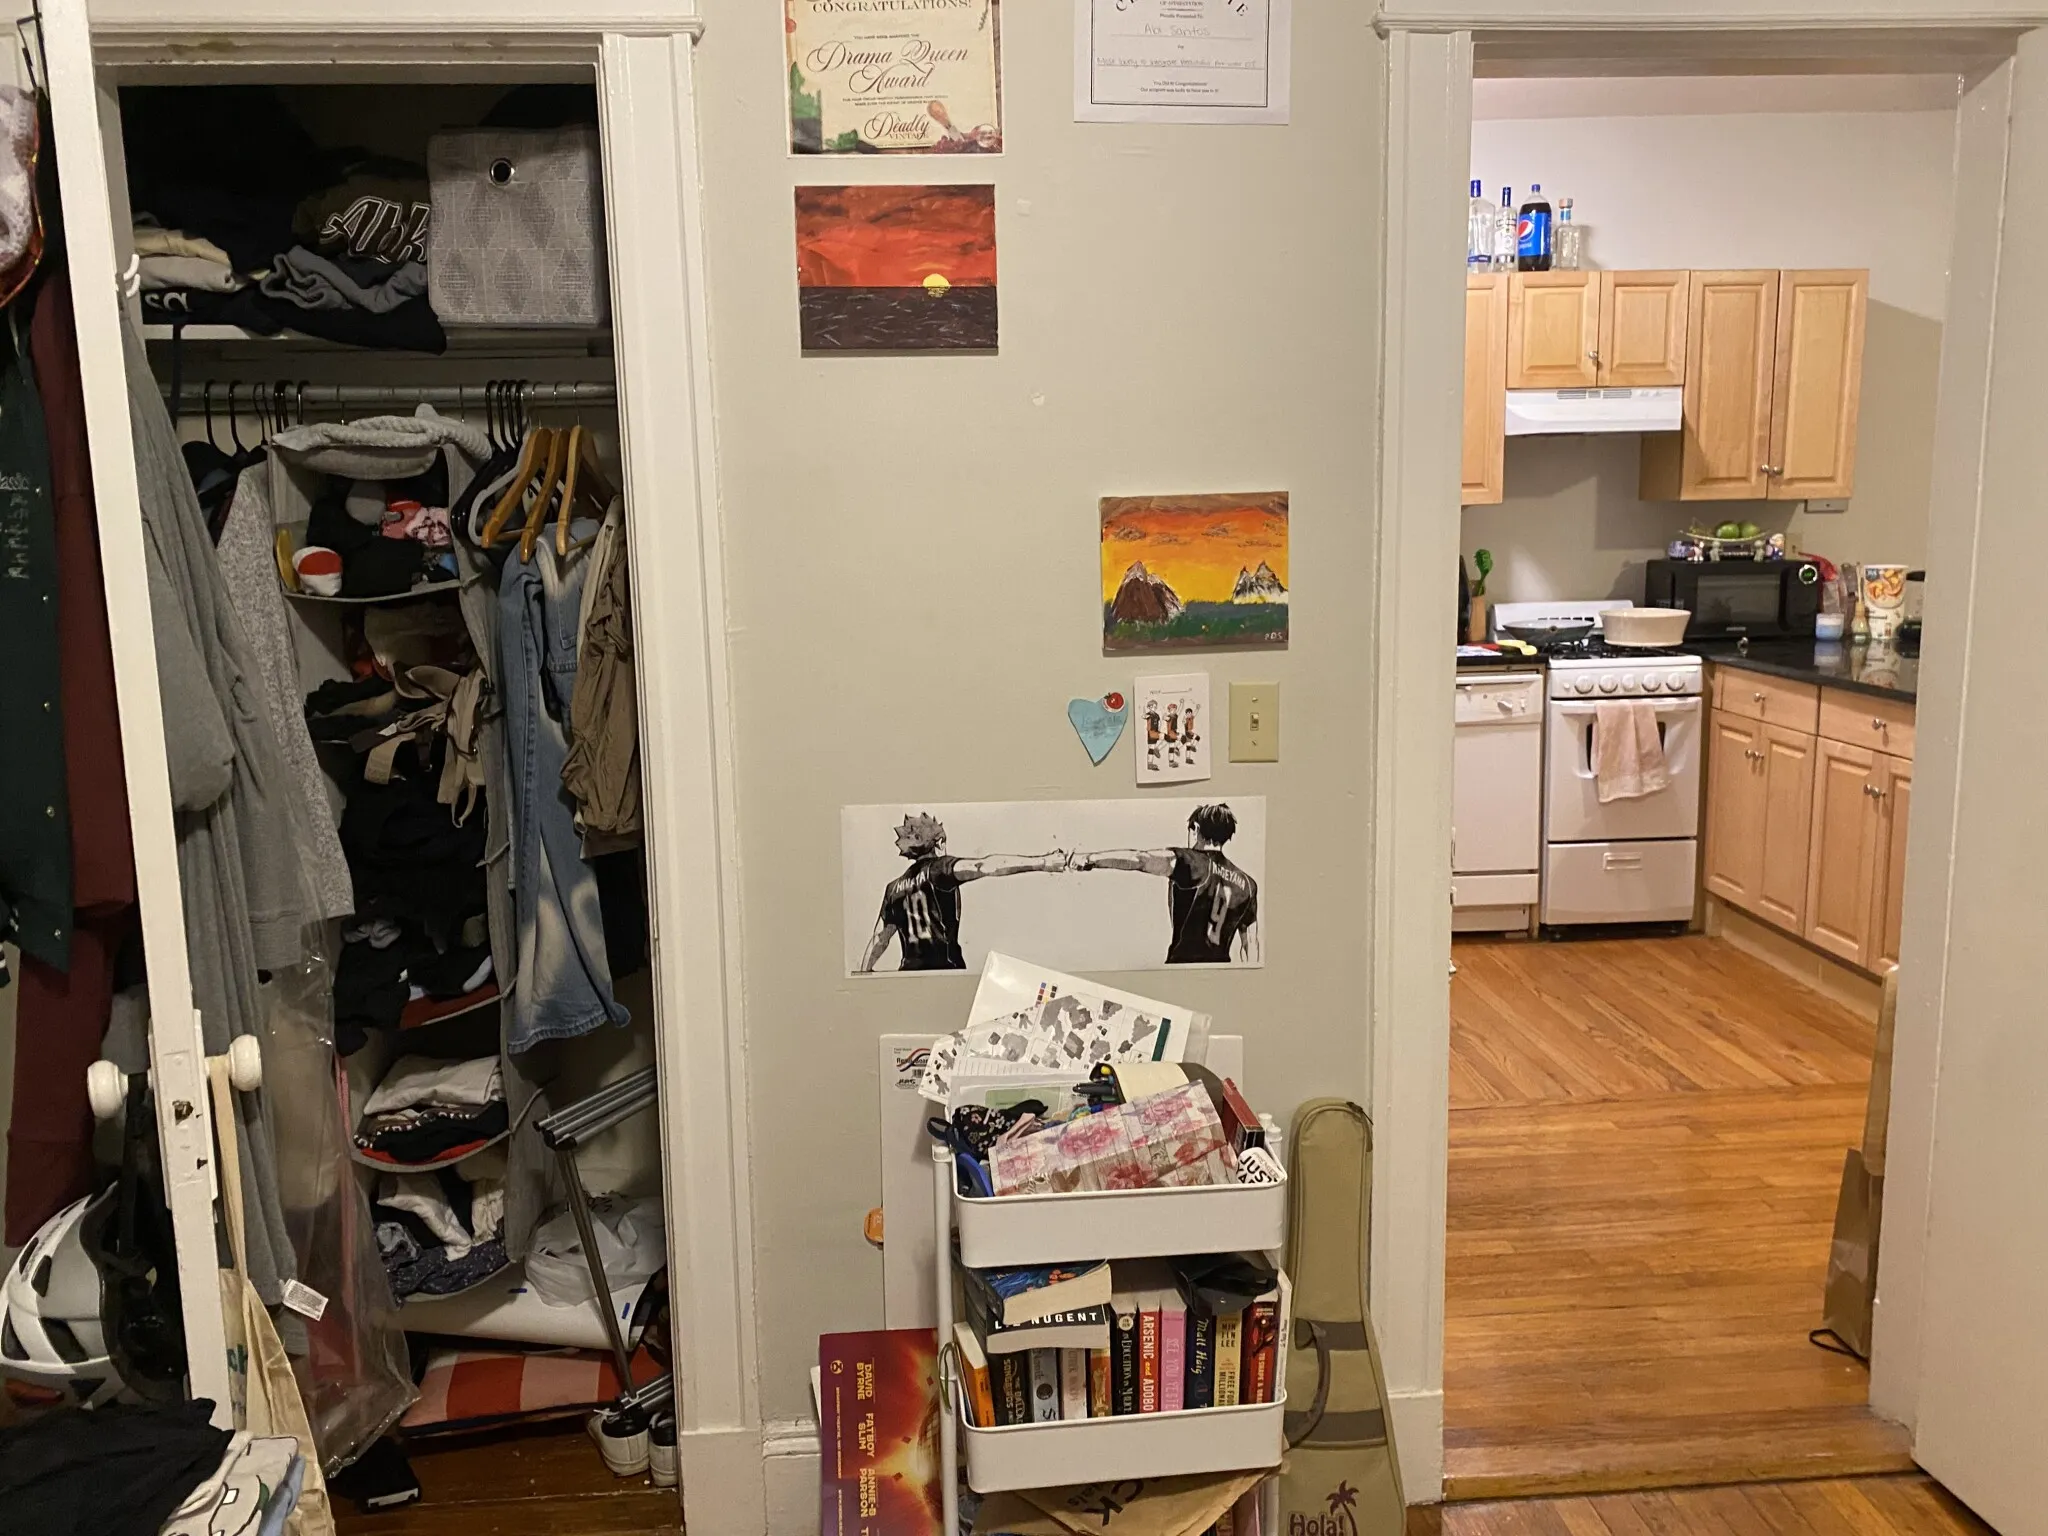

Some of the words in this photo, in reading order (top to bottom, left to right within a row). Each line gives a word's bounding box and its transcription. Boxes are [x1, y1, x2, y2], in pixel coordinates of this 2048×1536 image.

[813, 0, 973, 13] CONGRATULATIONS!
[806, 40, 893, 73] Drama
[899, 39, 968, 75] Queen
[849, 62, 935, 94] Award
[903, 889, 933, 944] 10
[1207, 881, 1232, 946] 9
[1031, 1311, 1098, 1325] NUGENT
[1196, 1318, 1209, 1347] Matt
[1143, 1315, 1155, 1359] ARSENIC
[1166, 1337, 1179, 1354] SEE
[1221, 1340, 1236, 1348] LEE
[1165, 1358, 1179, 1377] YOU
[1190, 1350, 1208, 1375] Haig
[856, 1362, 866, 1401] BYRNE
[863, 1363, 873, 1398] DAVID
[1143, 1378, 1155, 1411] ADOBO
[1227, 1371, 1236, 1389] FREE
[858, 1422, 867, 1450] SLIM
[865, 1412, 875, 1459] FATBOY
[859, 1467, 869, 1518] PARSON
[867, 1467, 877, 1517] ANNIE-B
[1289, 1512, 1345, 1536] Hola!
